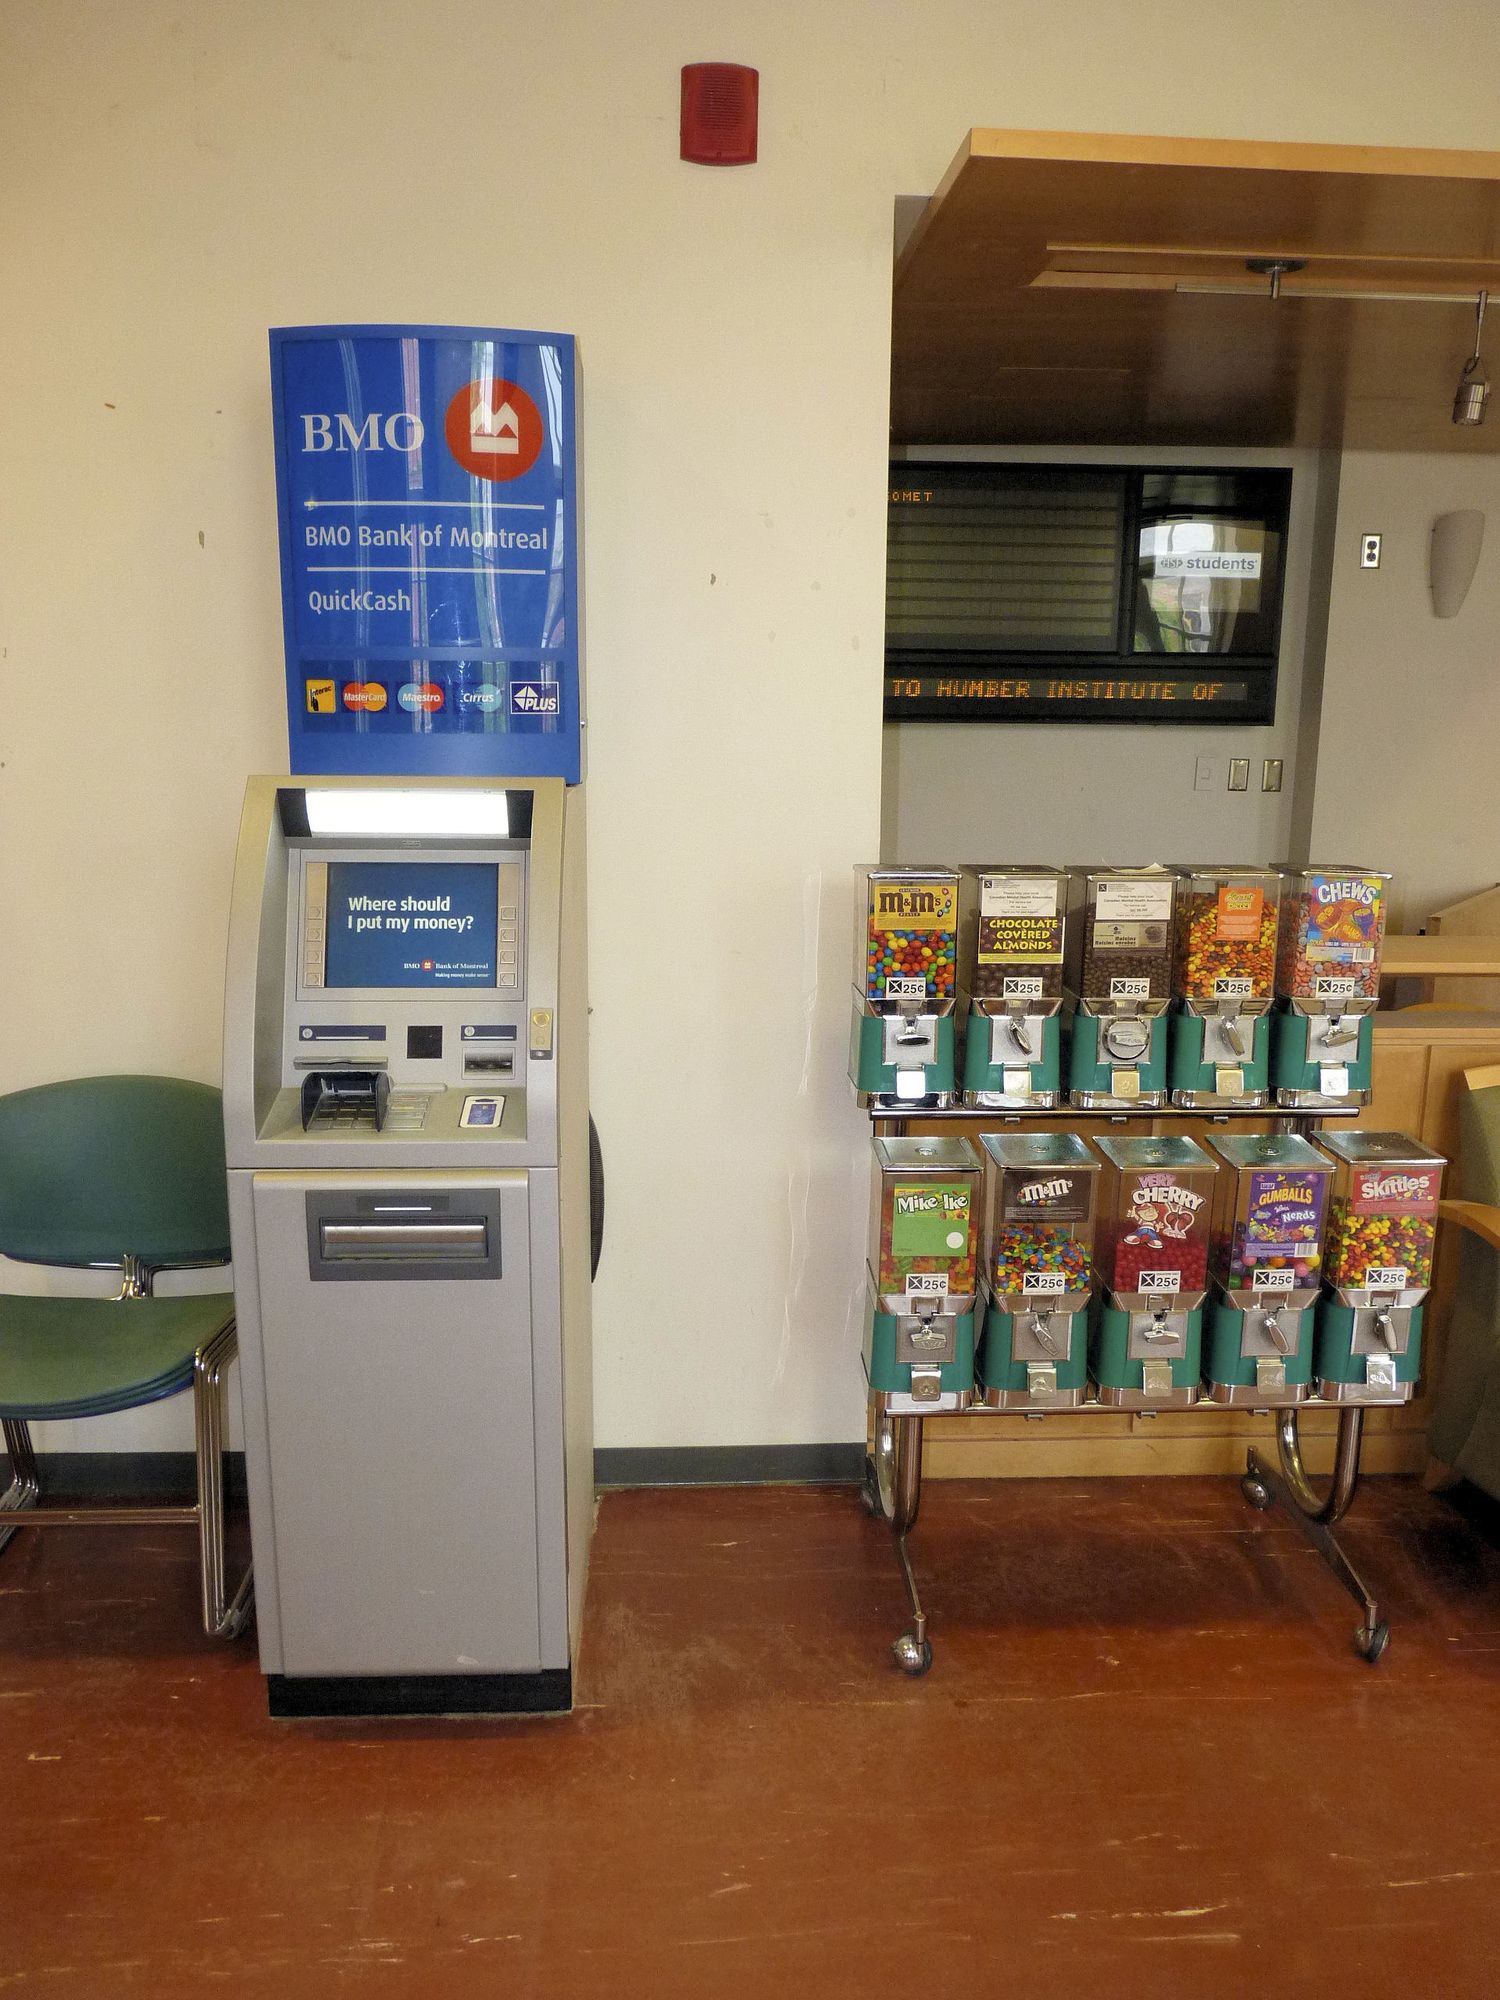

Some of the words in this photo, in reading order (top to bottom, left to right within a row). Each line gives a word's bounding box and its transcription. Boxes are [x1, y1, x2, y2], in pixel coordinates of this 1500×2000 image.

[300, 413, 424, 452] BMO
[305, 526, 350, 546] BMO
[358, 524, 413, 547] Bank
[420, 524, 442, 547] of
[450, 527, 548, 549] Montreal
[1186, 556, 1255, 570] students
[308, 589, 412, 615] QuickCash
[892, 679, 921, 697] TO
[937, 680, 1030, 698] HUMBER
[1046, 681, 1177, 700] INSTITUTE
[1192, 683, 1224, 700] OF
[343, 692, 386, 702] MasterCard
[402, 692, 440, 702] Maestro
[463, 692, 494, 703] Cirrus
[524, 697, 557, 711] PLUS
[1318, 881, 1377, 905] CHEWS
[348, 896, 397, 911] Where
[400, 896, 450, 911] should
[348, 915, 353, 929] I
[356, 915, 382, 933] put
[386, 917, 410, 933] my
[413, 915, 474, 933] money?
[989, 919, 1058, 928] CHOCOLATE
[996, 930, 1051, 939] COVERED
[993, 941, 1052, 950] ALMONDS
[903, 984, 924, 993] 25¢
[1019, 984, 1041, 993] 25¢
[1127, 984, 1148, 994] 25¢
[1230, 984, 1251, 993] 25¢
[1332, 984, 1352, 993] 25¢
[1361, 1176, 1430, 1199] Skittles
[1132, 1186, 1204, 1211] CHERRY
[1259, 1187, 1313, 1206] GUMBALLS
[897, 1195, 938, 1214] Mike
[943, 1193, 968, 1210] Ike
[1041, 1279, 1063, 1288] 25¢
[1156, 1277, 1178, 1287] 25¢
[1271, 1275, 1292, 1285] 25¢
[1383, 1274, 1404, 1283] 25¢
[924, 1280, 946, 1290] 25¢
